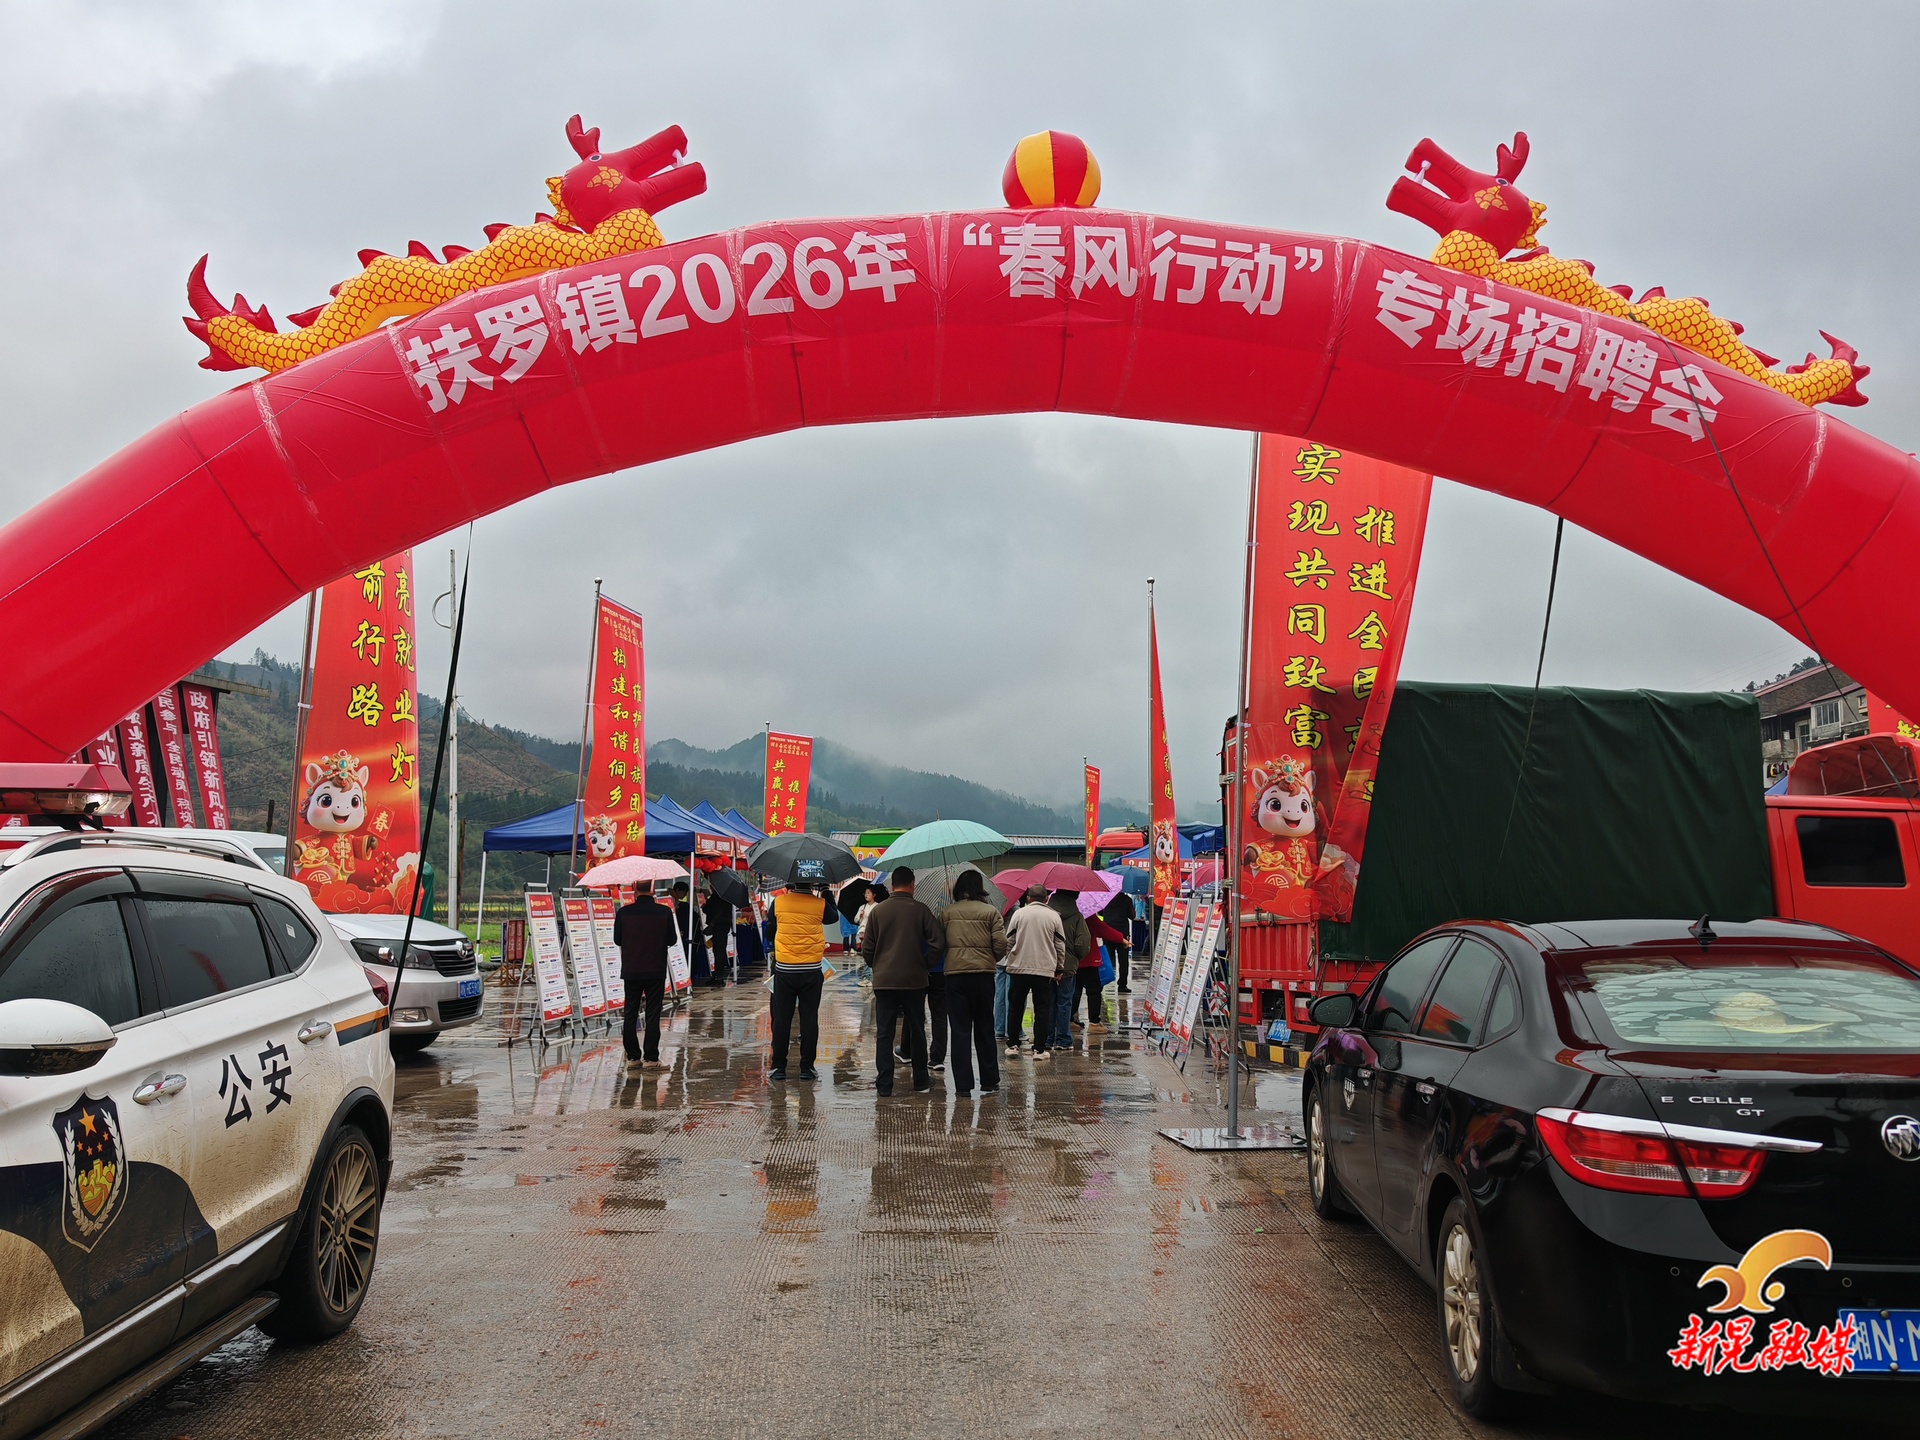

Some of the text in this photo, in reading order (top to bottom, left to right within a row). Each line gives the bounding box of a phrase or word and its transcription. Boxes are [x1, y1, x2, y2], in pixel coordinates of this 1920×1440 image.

[407, 221, 1724, 442] 扶罗镇2026年 “春风行动” 专场招聘会
[346, 561, 386, 727] 前行路
[389, 549, 416, 789] 亮就业灯
[1282, 443, 1341, 750] 实现共同致富
[188, 690, 226, 829] 政府引领新风尚
[605, 647, 629, 809] 构建和谐侗乡
[373, 811, 390, 834] 春
[218, 1040, 292, 1129] 公安
[1736, 1108, 1765, 1117] GT
